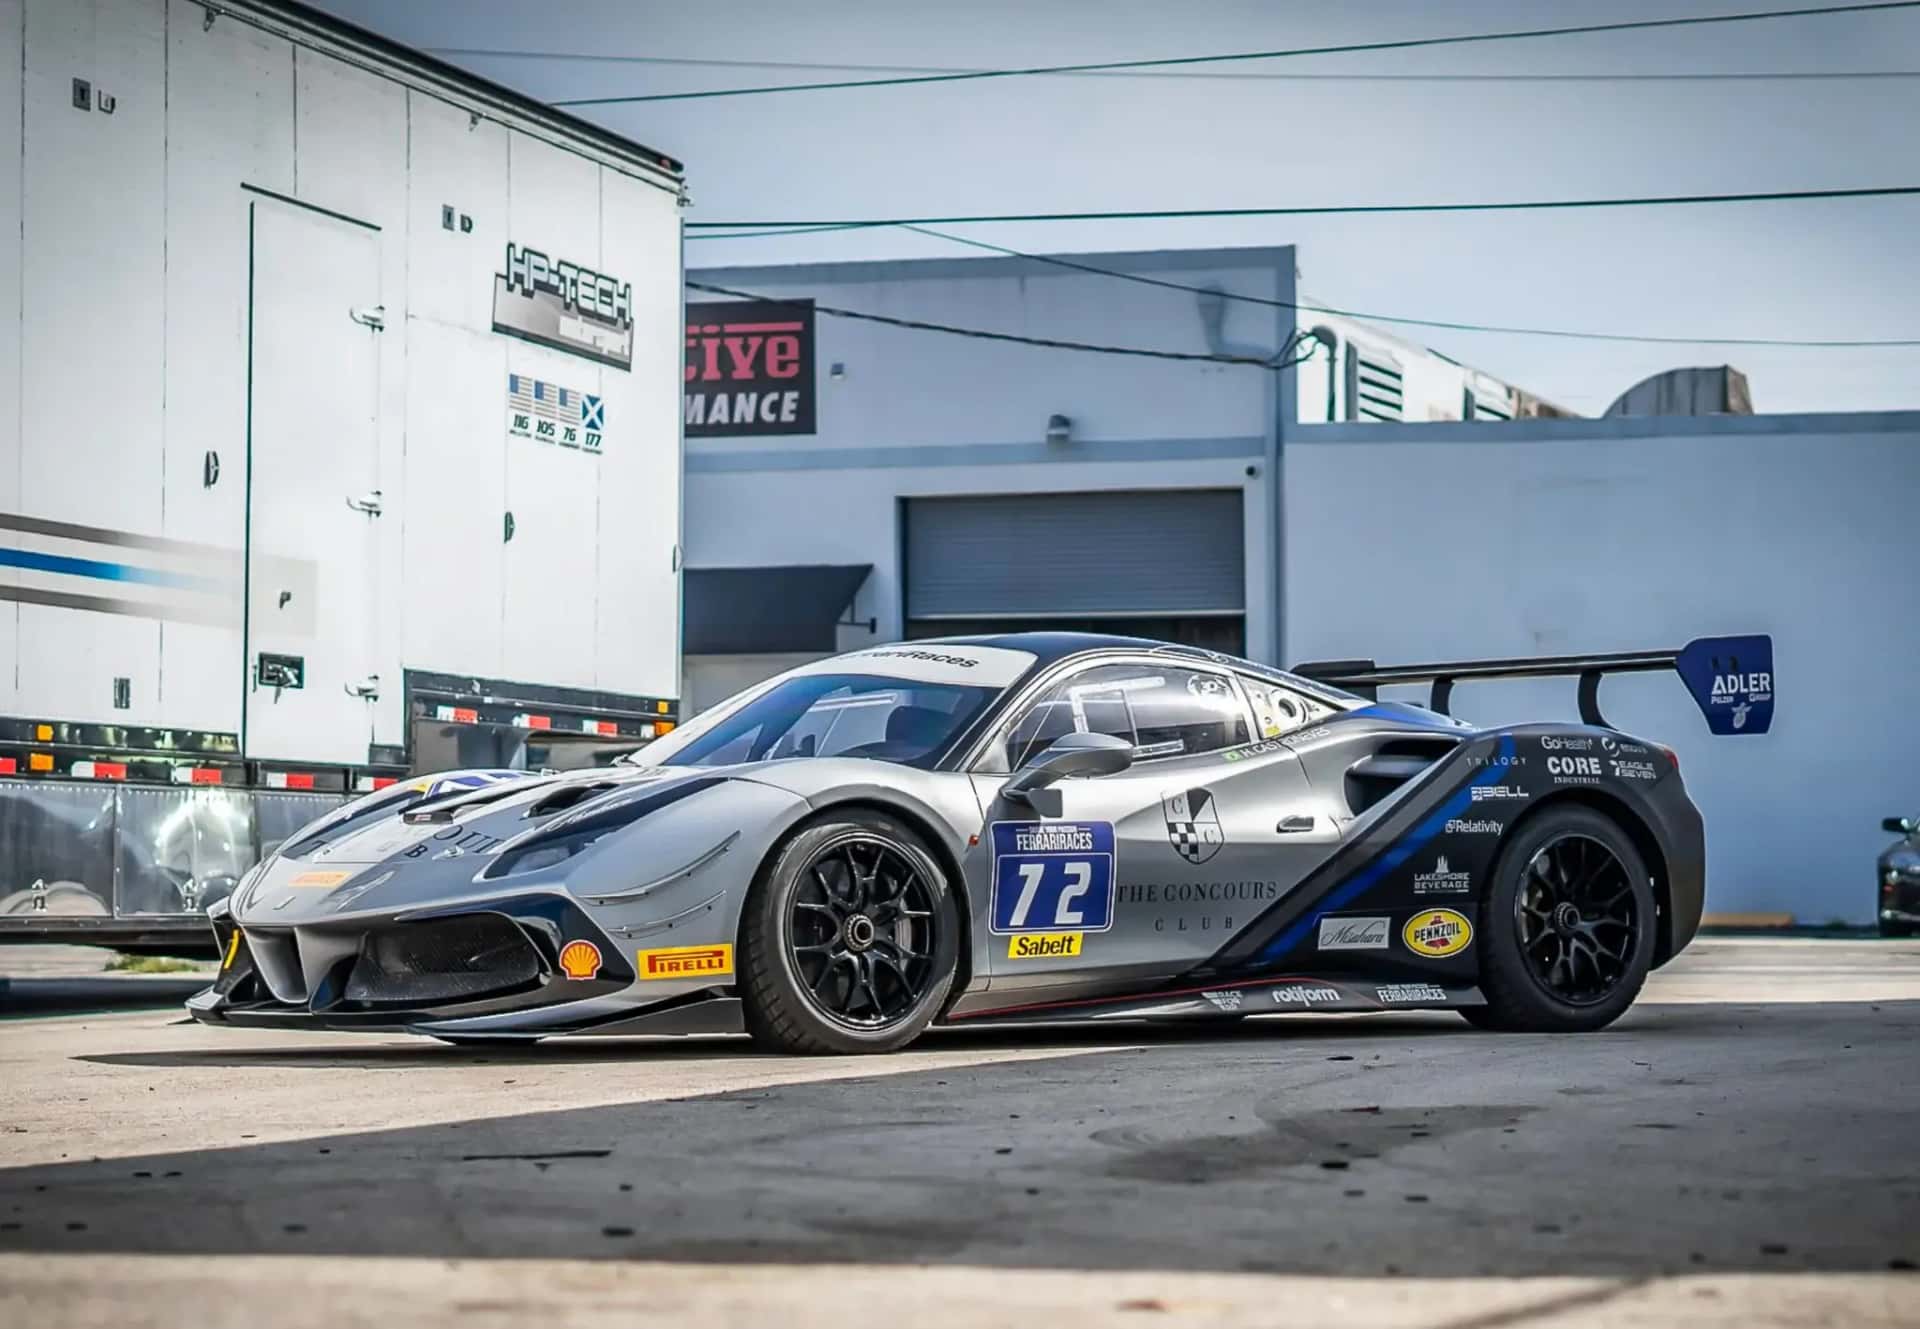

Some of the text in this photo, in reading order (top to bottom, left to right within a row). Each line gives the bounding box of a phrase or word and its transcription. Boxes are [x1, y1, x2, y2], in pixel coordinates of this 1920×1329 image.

[507, 242, 631, 329] HP-TECH
[537, 419, 555, 436] 105
[564, 427, 577, 441] 76
[586, 432, 602, 447] 177
[1711, 673, 1771, 695] ADLER
[1466, 756, 1526, 767] TRILOGY
[1547, 757, 1602, 775] CORE
[1482, 785, 1529, 798] BELL
[1456, 819, 1504, 836] Relativity
[1016, 833, 1093, 851] FERRARIRACES
[1414, 872, 1470, 881] LAKESHORE
[1414, 881, 1470, 889] BEVERAGE
[1009, 862, 1092, 927] 72
[1118, 881, 1277, 903] THE CONCOURS
[1155, 916, 1233, 931] CLUB
[1414, 921, 1461, 943] PENNZOIL
[1016, 936, 1075, 956] Sabelt
[648, 950, 724, 973] PIRELLI
[1272, 985, 1340, 1007] rotiform
